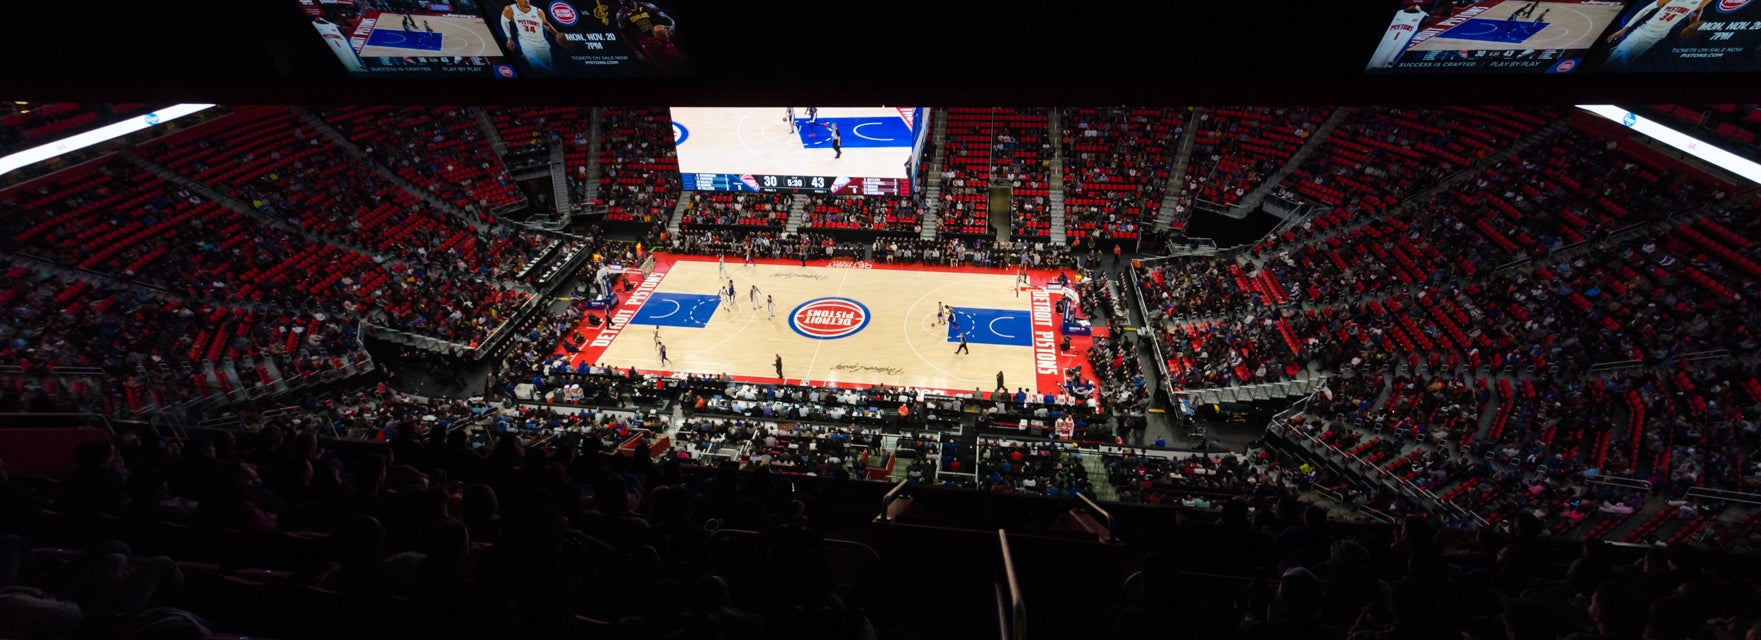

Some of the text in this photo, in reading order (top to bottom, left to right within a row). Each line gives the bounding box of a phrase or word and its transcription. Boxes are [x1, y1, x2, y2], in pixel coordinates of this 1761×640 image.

[1659, 12, 1677, 22] 34
[523, 25, 537, 33] 34
[605, 32, 616, 41] 20
[1393, 32, 1400, 40] 1
[1709, 32, 1735, 40] 7PM
[585, 42, 604, 50] 7PM
[763, 175, 778, 187] 30
[787, 179, 803, 187] 5:30
[811, 176, 825, 188] 43
[589, 272, 666, 347] DETROIT PISTONS
[806, 309, 855, 319] PISTONS
[803, 316, 852, 326] DETROIT
[1032, 289, 1058, 376] DETROIT PISTONS
